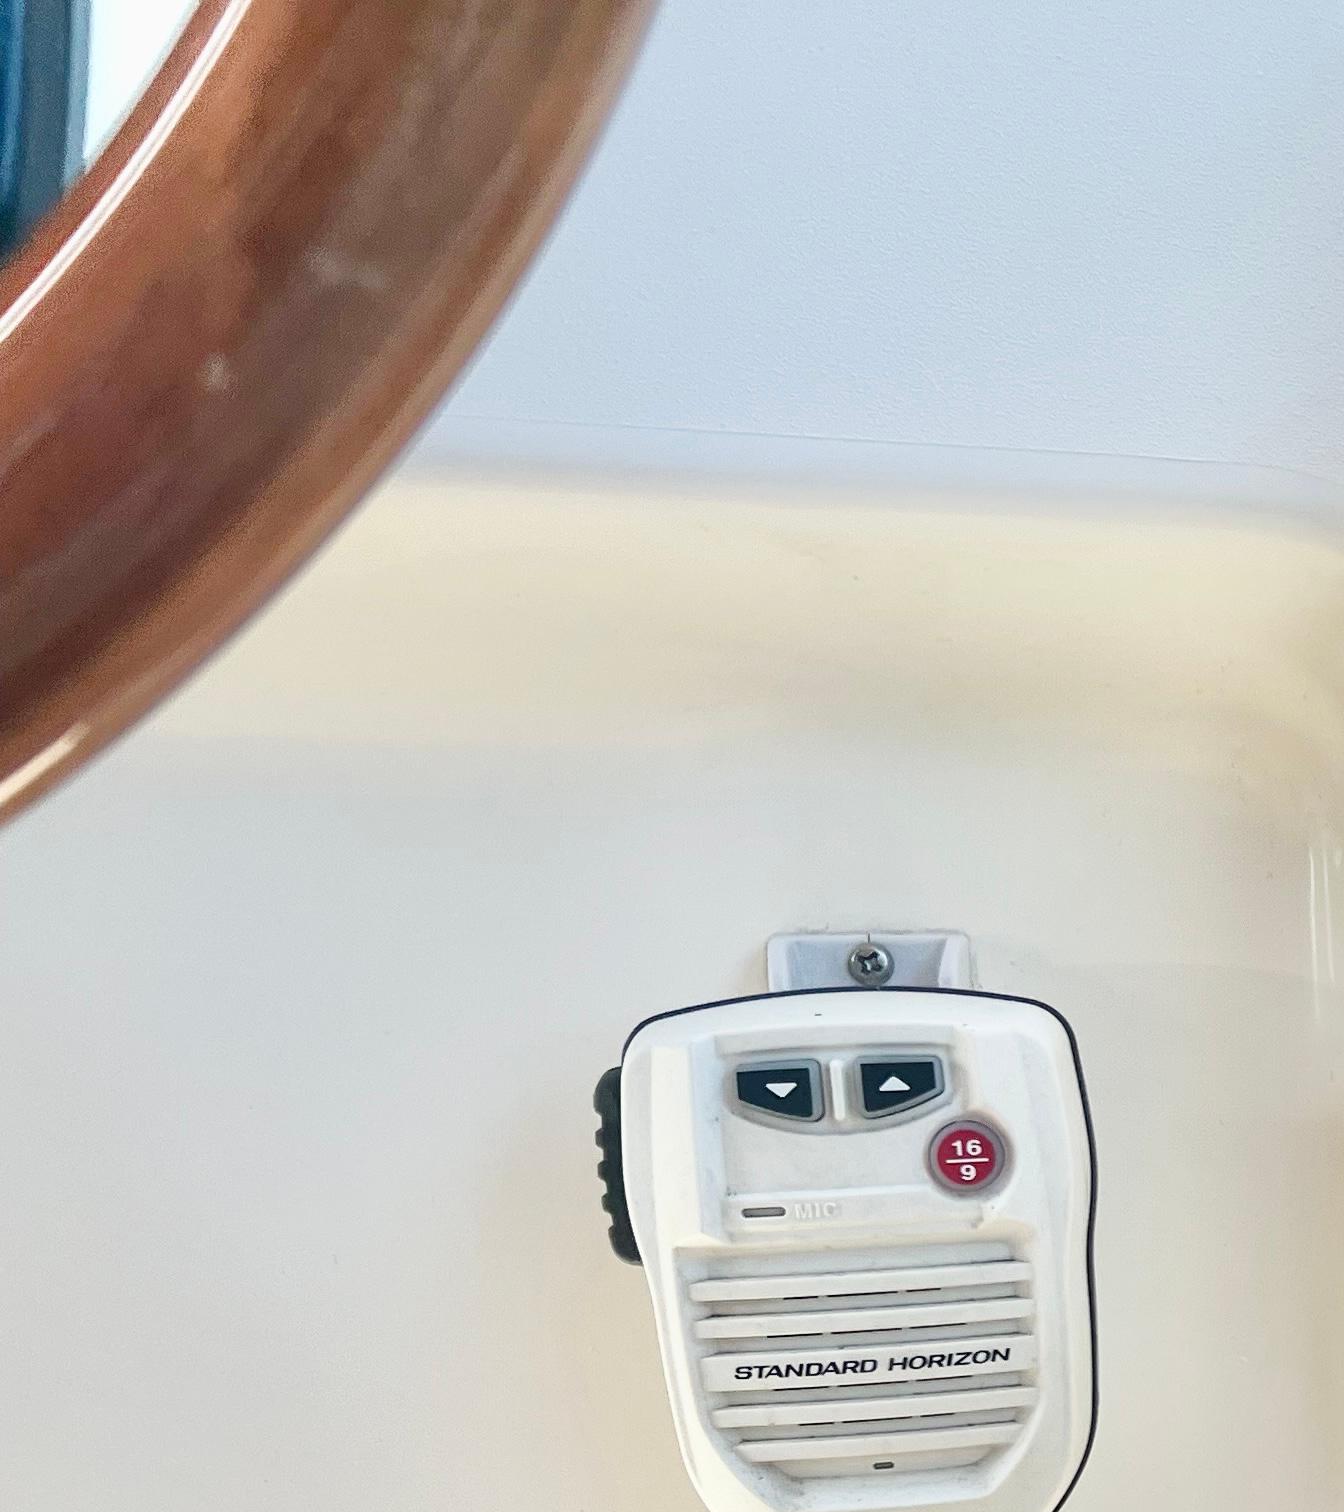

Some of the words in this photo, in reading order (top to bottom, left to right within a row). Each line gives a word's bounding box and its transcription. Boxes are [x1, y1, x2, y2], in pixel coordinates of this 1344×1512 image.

[951, 1138, 983, 1158] 16
[959, 1163, 978, 1182] 9
[794, 1202, 837, 1219] MIC
[734, 1358, 878, 1381] STANDARD
[887, 1347, 1011, 1372] HORIZON
